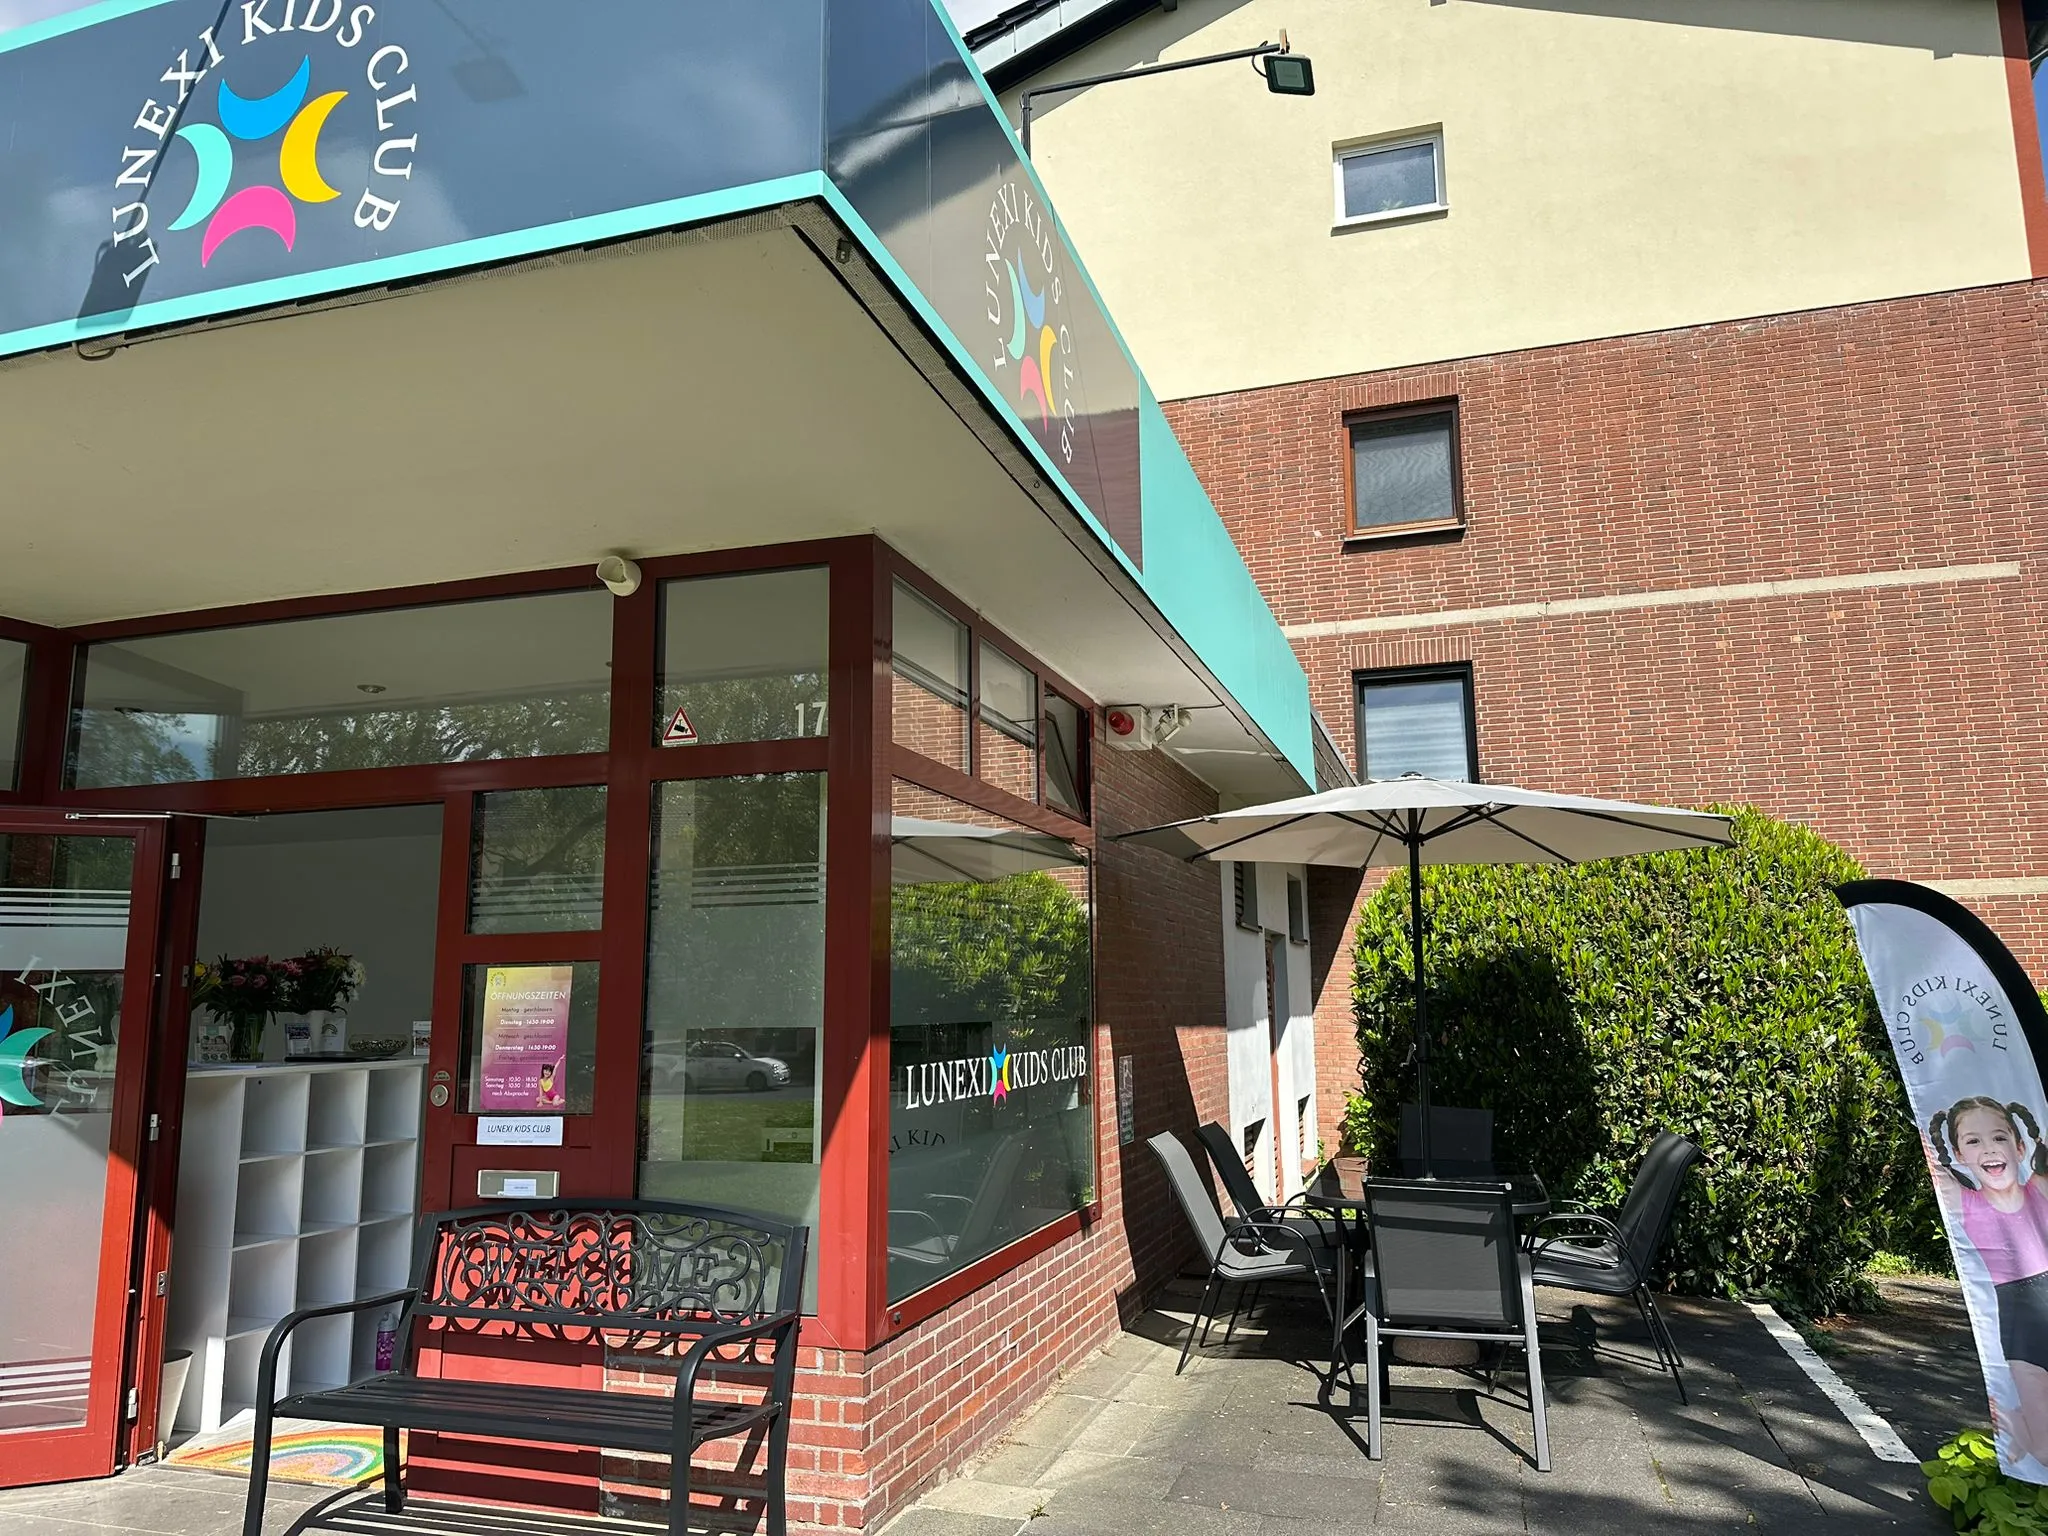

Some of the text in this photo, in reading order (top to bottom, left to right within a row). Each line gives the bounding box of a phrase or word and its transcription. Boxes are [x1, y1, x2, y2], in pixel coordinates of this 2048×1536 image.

[112, 0, 418, 288] LUNEXI KIDS CLUB
[985, 182, 1075, 464] LUNEXI KIDS CLUB
[795, 701, 827, 737] 17
[905, 1045, 1088, 1110] LUNEXI KIDS CLUB
[487, 1124, 551, 1133] LUNEXI KIDS CLUB
[477, 1241, 719, 1292] WELCOME
